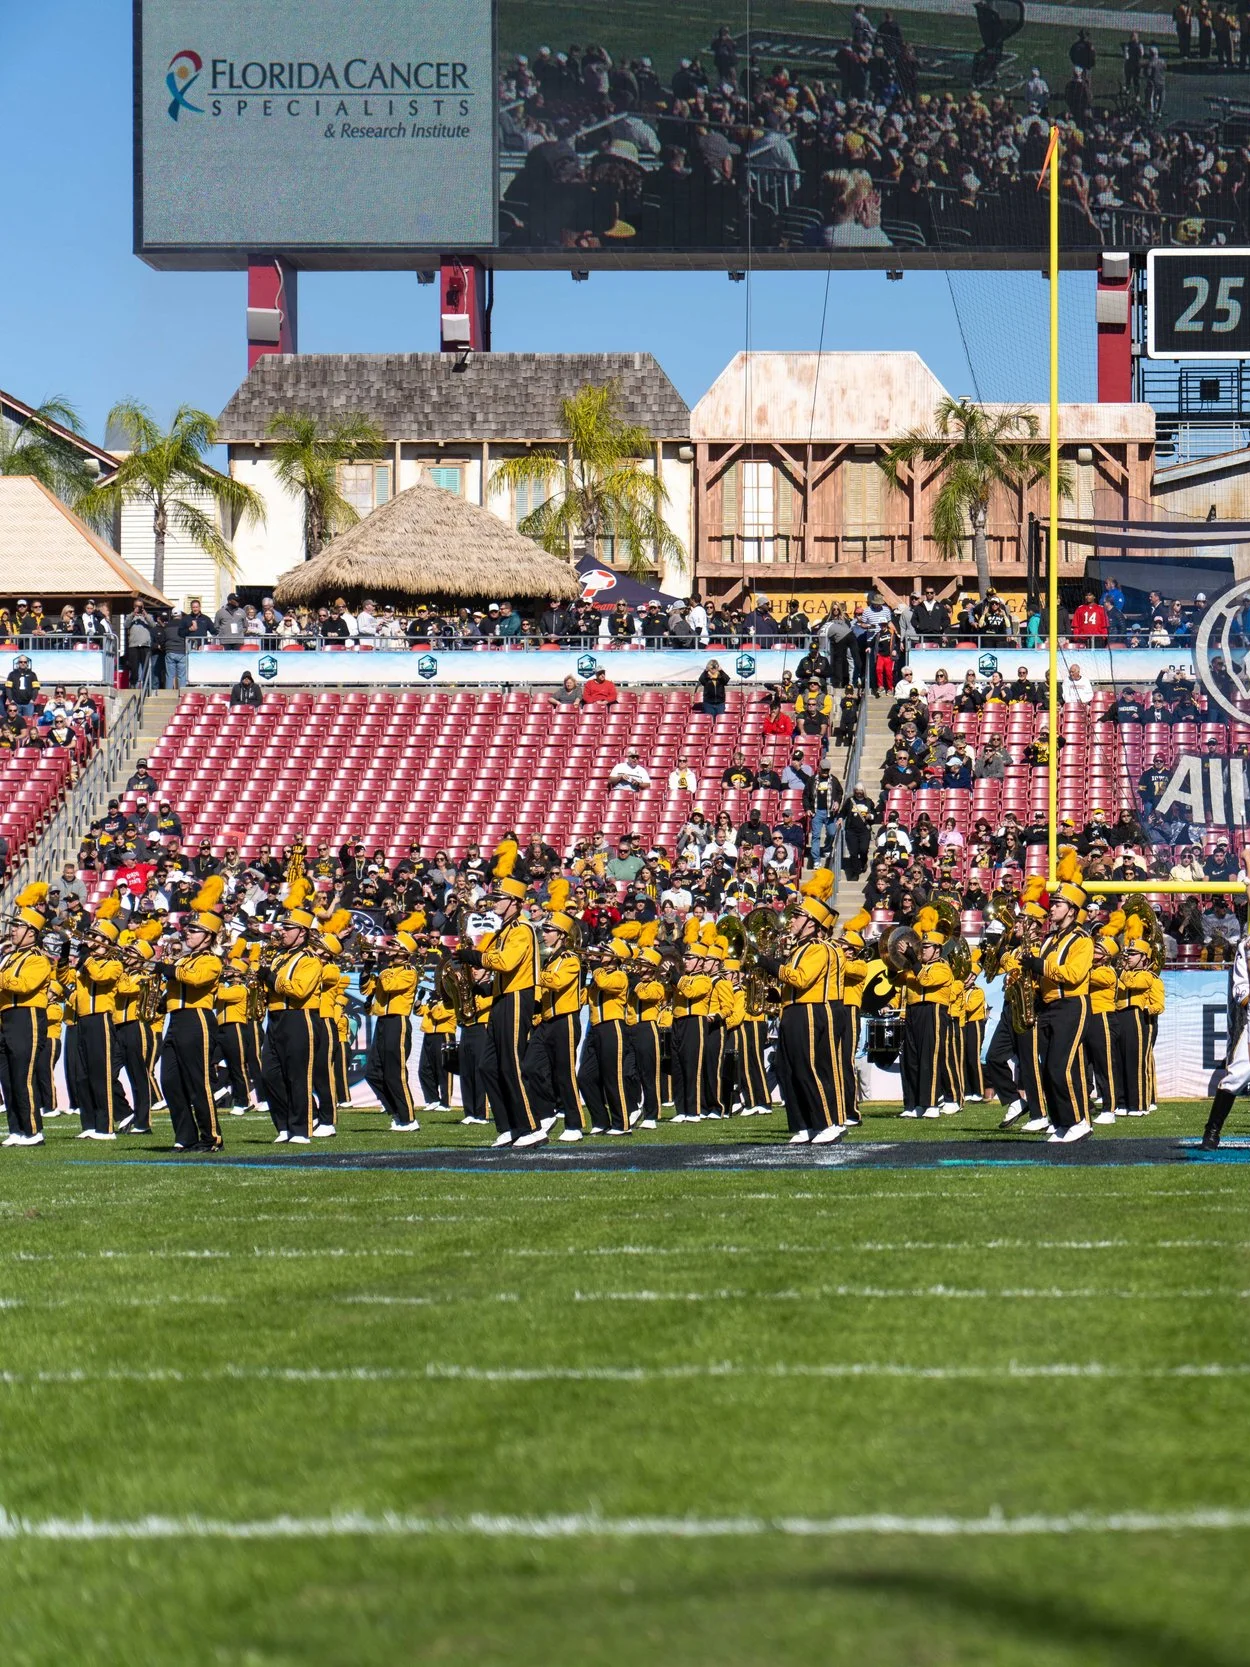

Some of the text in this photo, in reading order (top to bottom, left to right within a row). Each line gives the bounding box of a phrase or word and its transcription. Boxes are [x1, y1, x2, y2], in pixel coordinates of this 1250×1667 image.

[211, 59, 470, 89] FLORIDA CANCER
[212, 100, 469, 116] SPECIALISTS
[324, 122, 470, 138] & Research Institute
[1174, 276, 1245, 332] 25
[1083, 611, 1098, 625] 14
[19, 676, 26, 690] 1
[265, 909, 276, 923] 7
